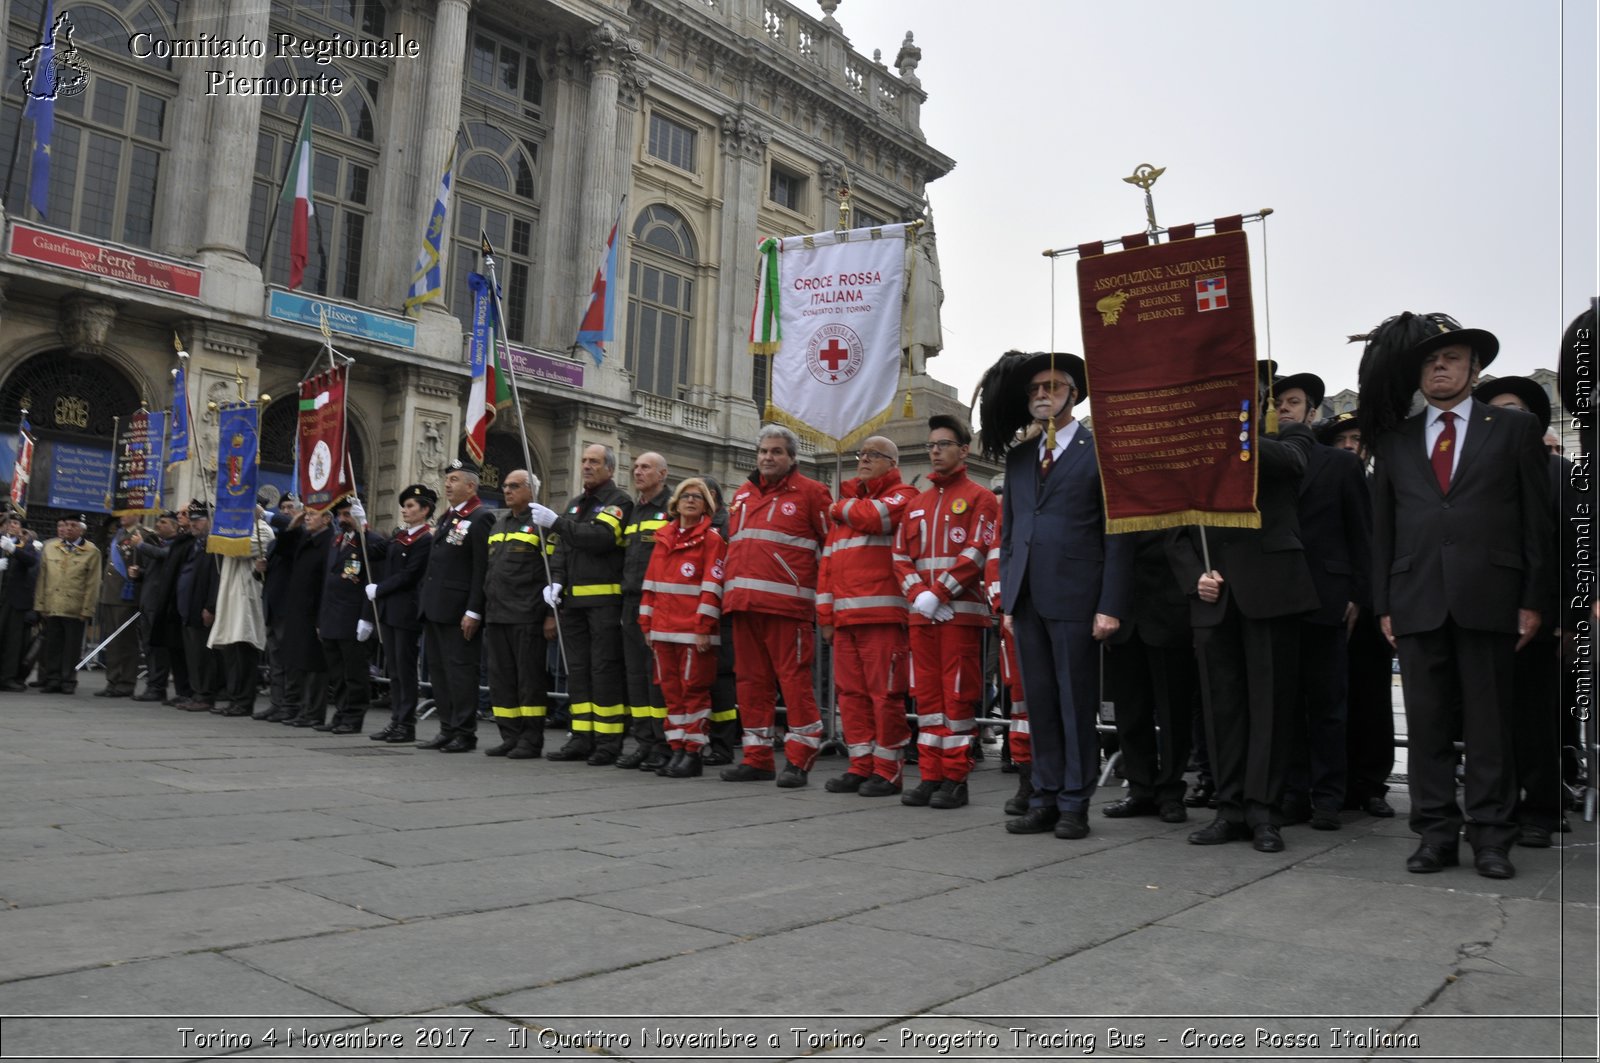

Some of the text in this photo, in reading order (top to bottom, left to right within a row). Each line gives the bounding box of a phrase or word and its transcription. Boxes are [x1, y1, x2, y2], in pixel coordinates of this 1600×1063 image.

[32, 236, 136, 271] Gianfranco Ferré
[80, 260, 108, 275] Sotto
[150, 275, 170, 290] luce
[794, 271, 881, 291] CROCE ROSSA
[1093, 256, 1227, 291] ASSOCIAZIONE NAZIONALE
[810, 289, 864, 306] ITALIANA
[1129, 279, 1190, 297] BERSAGLIERI
[802, 305, 872, 316] COMITATO DI TORINO
[1140, 294, 1182, 308] REGIONE
[311, 302, 358, 324] Odissee
[1138, 307, 1184, 322] PIEMONTE
[823, 325, 849, 337] GINEVRA
[851, 341, 862, 365] AGOSTO
